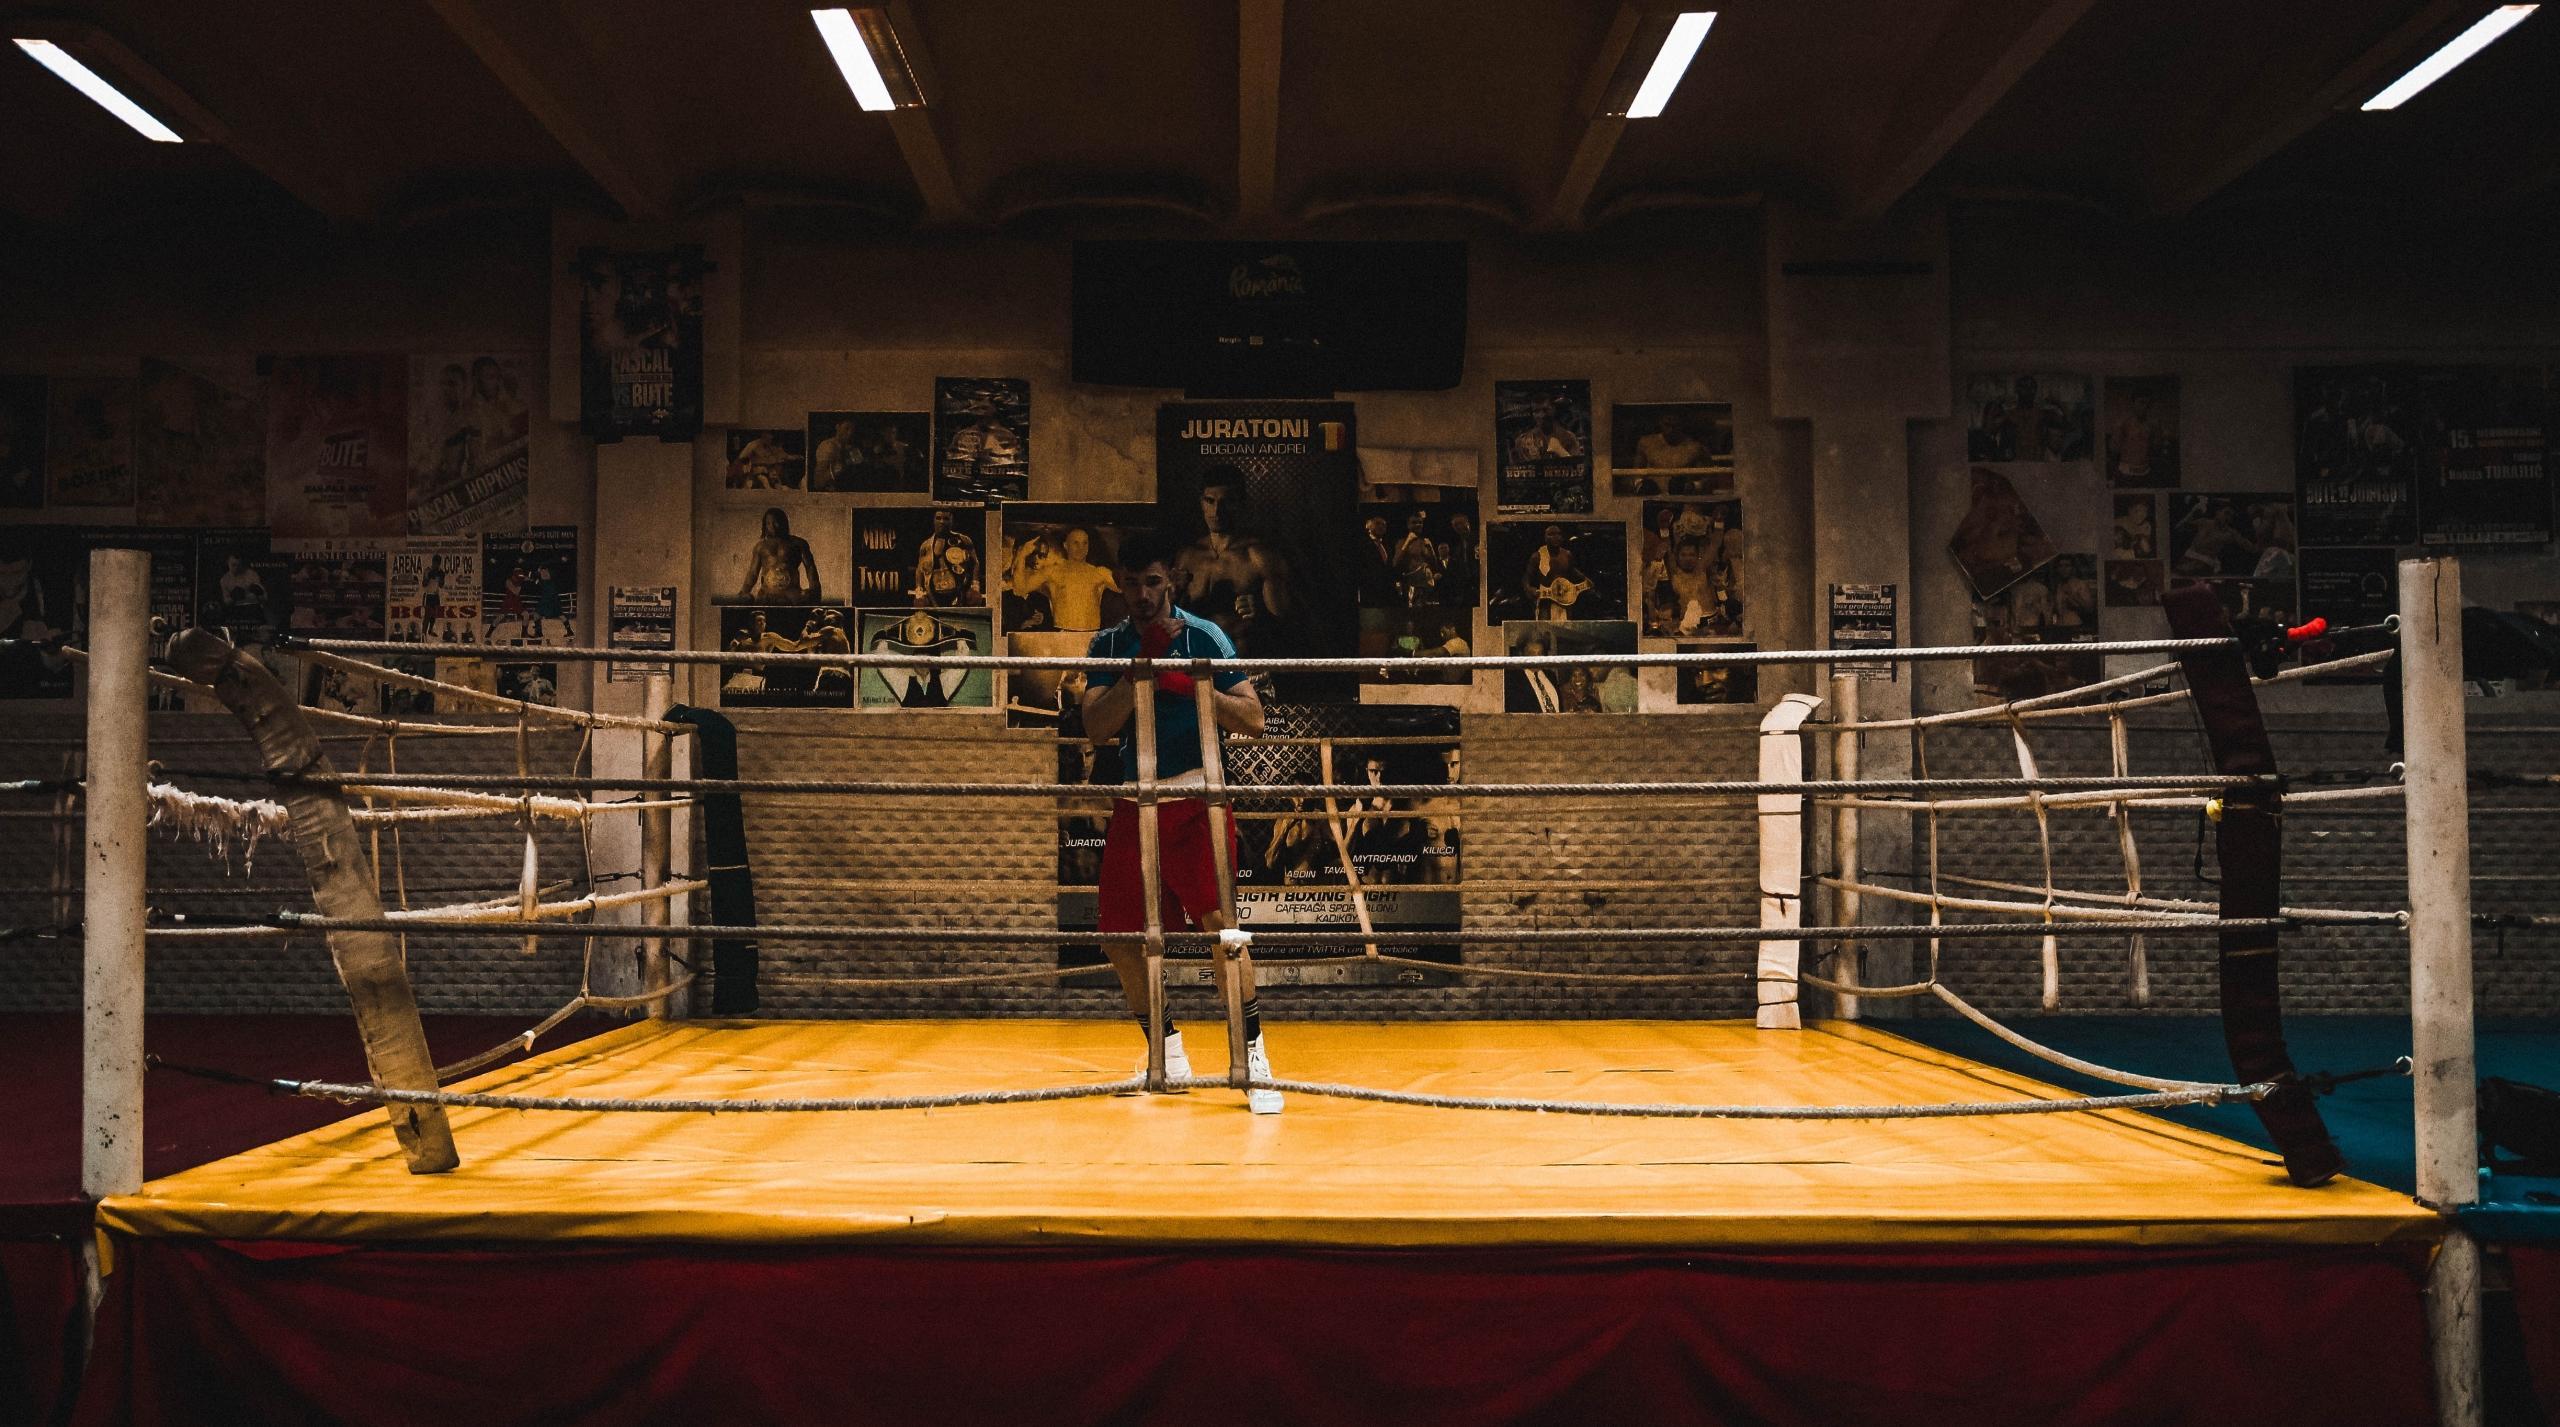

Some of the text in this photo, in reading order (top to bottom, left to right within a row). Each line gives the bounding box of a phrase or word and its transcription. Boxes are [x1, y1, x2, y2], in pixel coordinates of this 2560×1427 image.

[632, 382, 673, 408] BUTE
[1180, 417, 1310, 439] JURATONI
[1200, 443, 1306, 456] BOGDAN ANDREI
[408, 491, 463, 526] PASCAL
[464, 457, 529, 503] HOPKINS
[392, 555, 422, 574] ARENA
[444, 555, 461, 574] CUP
[1265, 717, 1286, 725] AIBA
[1352, 854, 1418, 864] MYTROFANOV
[1323, 866, 1366, 876] TAVAES
[1284, 891, 1346, 902] BOXING
[1328, 903, 1356, 913] SPOR
[1366, 904, 1399, 913] ALONU
